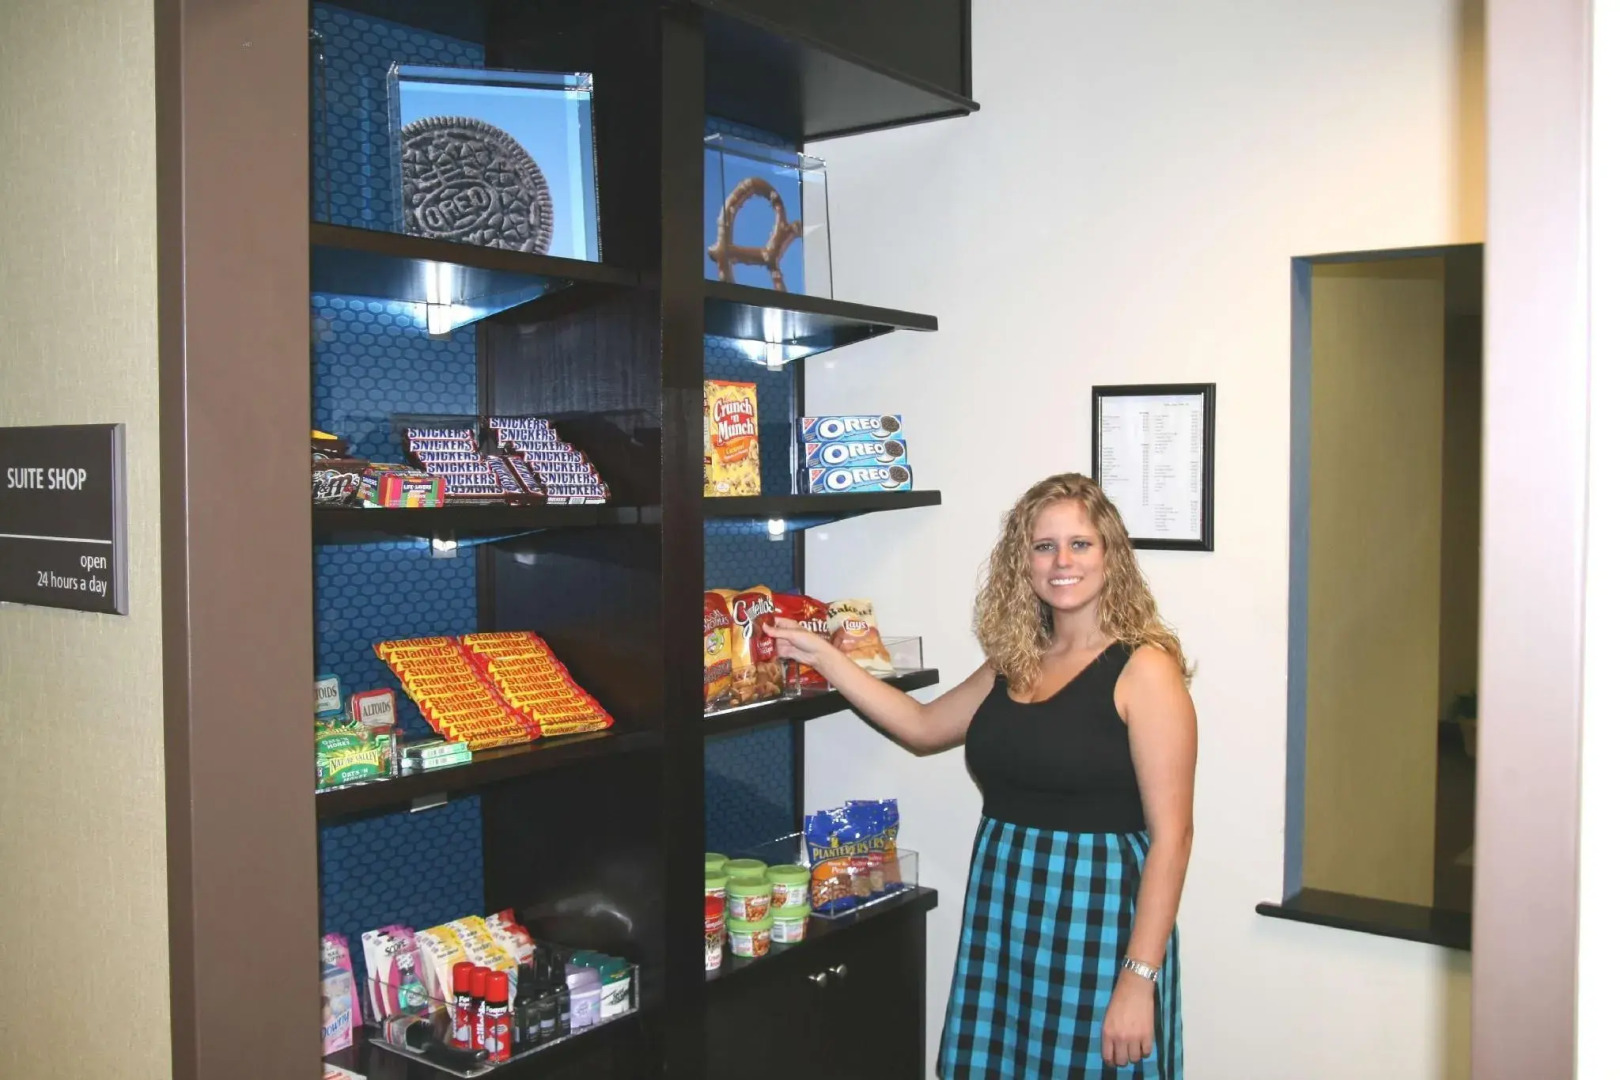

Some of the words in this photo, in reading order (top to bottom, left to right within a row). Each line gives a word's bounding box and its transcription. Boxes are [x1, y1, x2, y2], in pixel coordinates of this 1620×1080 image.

[425, 186, 490, 228] OREO
[714, 398, 753, 422] Crunch
[491, 418, 547, 429] SNICKERS
[819, 418, 880, 438] OREO
[410, 428, 469, 438] SNICKERS
[501, 429, 555, 440] SNICKERS
[718, 418, 754, 444] Munch
[413, 440, 471, 450] SNICKERS
[515, 441, 569, 451] SNICKERS
[420, 451, 479, 461] SNICKERS
[526, 452, 580, 462] SNICKERS
[823, 442, 884, 463] OREO
[428, 462, 487, 472] SNICKERS
[533, 462, 588, 473] SNICKERS
[7, 467, 44, 489] SUITE
[48, 468, 87, 490] SHOP
[445, 474, 495, 485] NICKERS
[540, 473, 597, 484] SNICKERS
[827, 468, 889, 488] OREO
[548, 484, 603, 496] SNICKERS
[80, 555, 107, 572] open
[37, 570, 49, 587] 24
[51, 570, 78, 590] hours
[80, 578, 86, 591] a
[89, 575, 107, 597] day
[387, 637, 446, 649] Starburst
[397, 645, 456, 659] Starburst
[402, 656, 461, 669] Starburst
[409, 664, 468, 677] Starburst
[415, 673, 476, 687] Starburst
[422, 682, 482, 696] Starburst
[515, 688, 572, 702] Starburst
[363, 701, 391, 717] ALTOIDS
[446, 707, 503, 723] Starburst
[456, 716, 513, 732] Starburst
[385, 940, 406, 955] SCOPE
